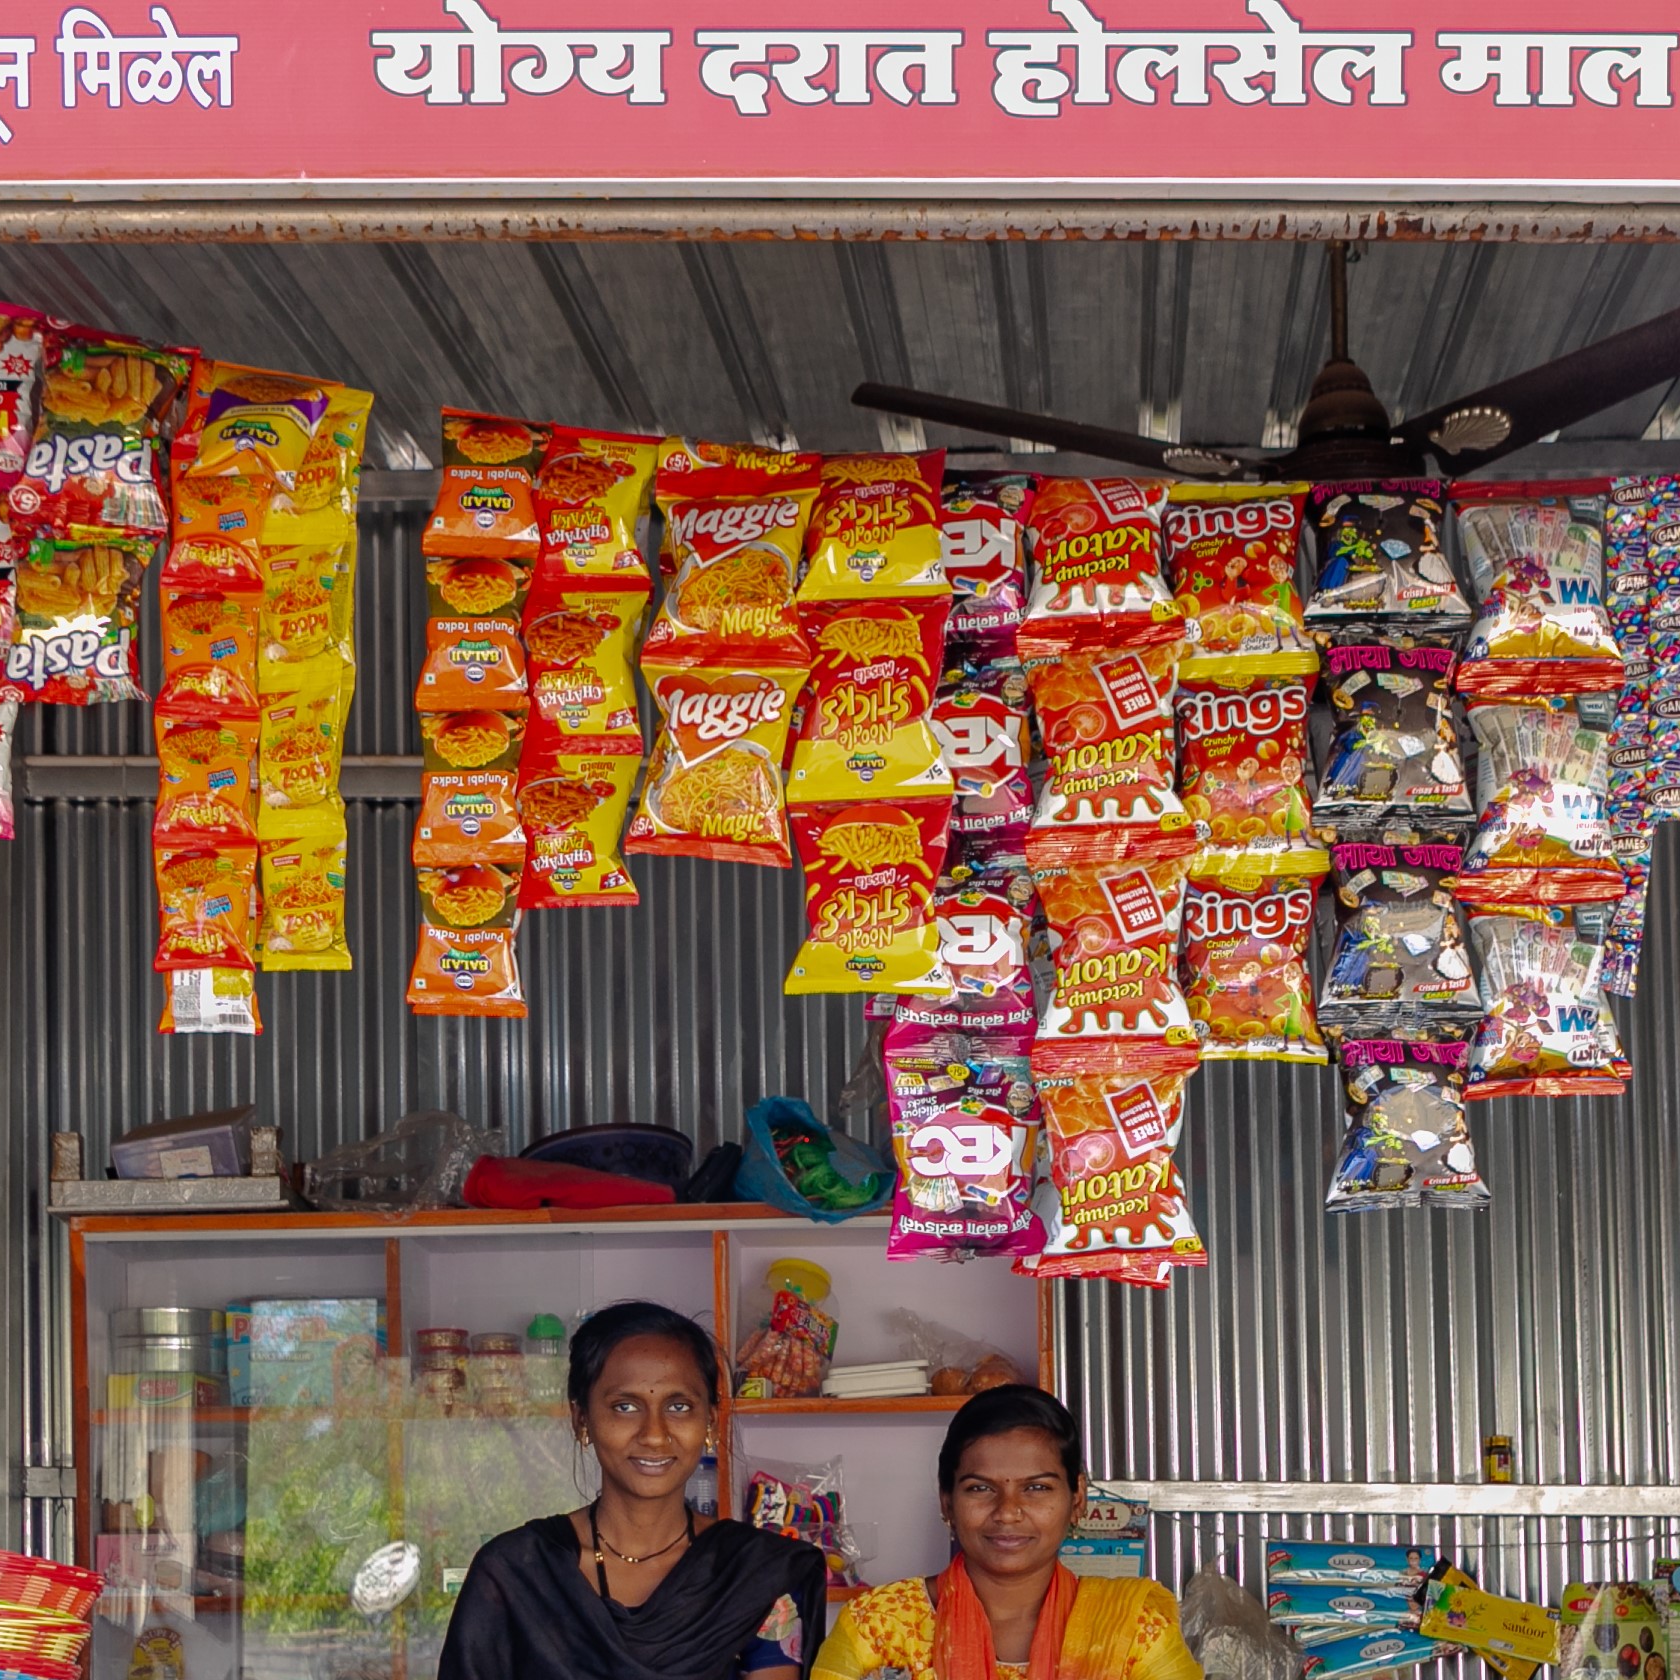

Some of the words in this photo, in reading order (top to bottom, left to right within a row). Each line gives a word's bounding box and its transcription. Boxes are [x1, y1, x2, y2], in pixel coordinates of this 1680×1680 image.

[54, 5, 240, 110] मिळेल
[370, 0, 672, 105] योग्य
[695, 30, 964, 116] दरात
[986, 0, 1414, 117] होलसेल
[1436, 32, 1680, 107] माल
[222, 427, 278, 446] BALAJI
[23, 431, 150, 493] Pasta
[736, 450, 796, 475] Magic
[450, 468, 483, 481] Tadka
[855, 482, 895, 498] Masala
[462, 494, 512, 510] BALAJI
[825, 497, 912, 529] STICKS
[551, 510, 603, 528] PATAKA
[672, 499, 800, 543] Maggie
[546, 524, 610, 546] CHATAKA
[842, 519, 895, 545] Noodle
[1045, 525, 1153, 566] Katori
[1196, 548, 1220, 559] Crispy
[1055, 552, 1131, 581] Ketchup
[1402, 587, 1424, 598] Crispy
[1433, 583, 1451, 594] Tasty
[437, 622, 469, 634] Tadka
[472, 620, 514, 634] Punjabi
[721, 602, 783, 636] Magic
[4, 629, 130, 691] Pasta
[451, 649, 500, 664] BALAJI
[541, 671, 594, 690] PATAKA
[853, 662, 895, 684] Masala
[538, 685, 602, 708] CHATAKA
[820, 678, 910, 732] STICKS
[838, 718, 894, 747] Noodle
[1053, 732, 1162, 783] Katori
[1208, 746, 1232, 758] Crispy
[432, 774, 465, 787] Tadka
[468, 773, 509, 787] Punjabi
[1063, 768, 1140, 798] Ketchup
[1412, 786, 1433, 796] Crispy
[1441, 784, 1458, 794] Tasty
[702, 812, 765, 842] Magic
[531, 849, 592, 873] CHATAKA
[820, 887, 911, 940] STICKS
[1125, 902, 1159, 924] FREE
[838, 920, 893, 953] Noodle
[1067, 979, 1144, 1009] Ketchup
[901, 1103, 946, 1120] Delicious
[907, 1095, 937, 1109] Snacks
[1131, 1122, 1161, 1142] FREE
[909, 1124, 1013, 1177] KBC
[966, 1221, 1009, 1237] बनेगा
[1089, 1507, 1118, 1521] A1
[1332, 1557, 1371, 1567] ULLAS
[1332, 1600, 1371, 1610] ULLAS
[1500, 1619, 1548, 1640] santoor
[1362, 1640, 1403, 1657] ULLAS
